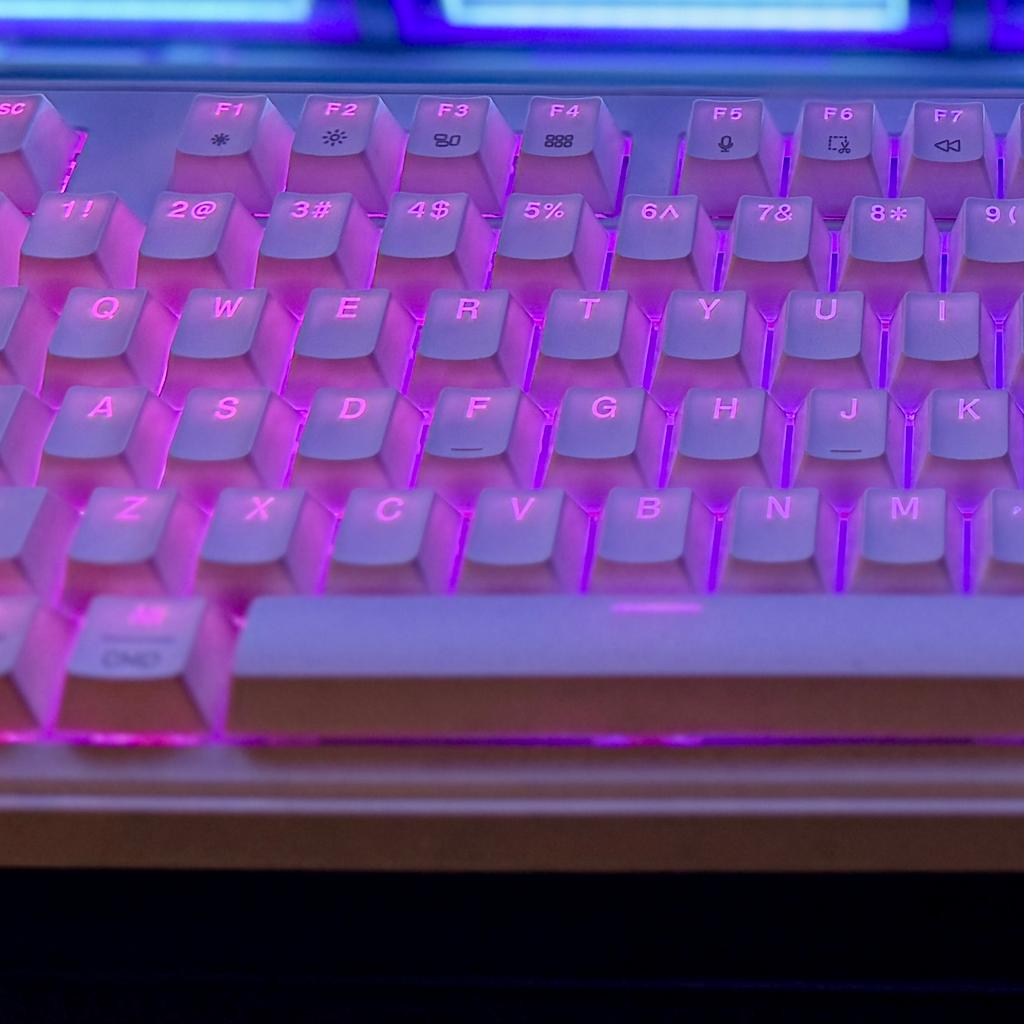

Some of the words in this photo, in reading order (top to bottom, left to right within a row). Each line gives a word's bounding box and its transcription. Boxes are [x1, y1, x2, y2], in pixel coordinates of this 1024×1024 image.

[214, 103, 243, 116] F1
[325, 103, 357, 116] F2
[438, 104, 469, 117] F3
[550, 104, 579, 117] F4
[713, 107, 742, 120] F5
[824, 107, 853, 120] F6
[935, 109, 963, 123] F7
[167, 201, 216, 220] 2@
[291, 201, 332, 218] 3#
[407, 200, 450, 220] 4$
[524, 202, 564, 219] 5%
[758, 204, 792, 222] 7&
[92, 297, 119, 319] Q
[214, 297, 243, 318] W
[336, 297, 361, 318] E
[456, 298, 481, 320] R
[579, 299, 600, 319] T
[696, 299, 720, 319] Y
[815, 299, 837, 320] U
[88, 396, 113, 417] A
[214, 397, 239, 419] S
[339, 398, 366, 419] D
[466, 397, 491, 418] F
[592, 396, 617, 418] G
[713, 398, 738, 419] H
[840, 398, 857, 419] J
[959, 399, 980, 420] K
[115, 496, 148, 520] Z
[245, 497, 275, 520] X
[375, 497, 404, 522] C
[511, 497, 536, 520] V
[636, 497, 662, 519] B
[766, 496, 793, 519] N
[891, 497, 919, 519] M
